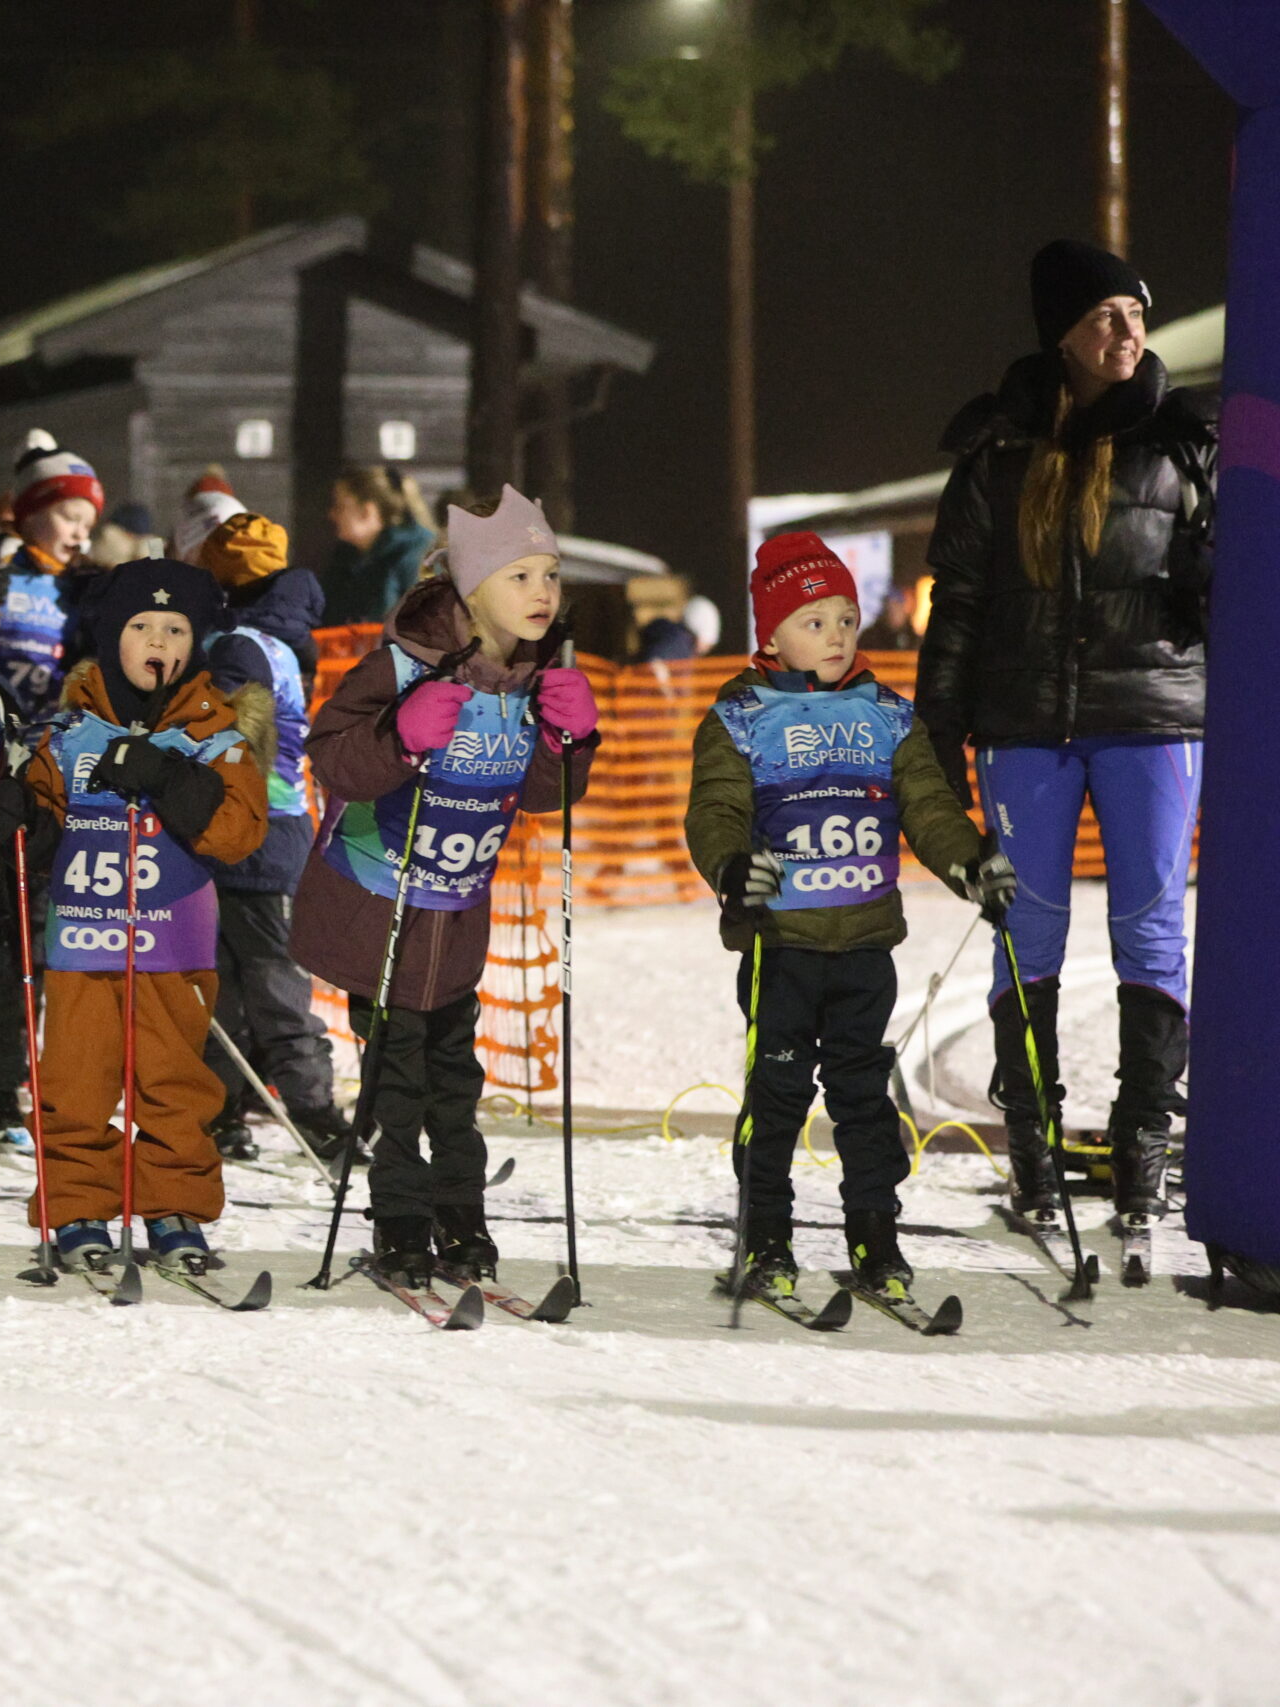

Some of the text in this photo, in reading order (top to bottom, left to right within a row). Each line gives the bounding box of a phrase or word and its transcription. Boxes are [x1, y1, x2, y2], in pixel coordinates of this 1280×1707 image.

[483, 731, 530, 759] VVS
[818, 721, 874, 748] VVS
[441, 756, 528, 776] EKSPERTEN
[788, 748, 875, 769] EKSPERTEN
[422, 789, 502, 813] SpareBank
[65, 815, 155, 833] SpareBan 1
[786, 815, 883, 858] 166
[413, 824, 506, 873] 196
[64, 844, 160, 897] 456
[792, 863, 884, 892] coop
[107, 907, 172, 922] MII-VM
[562, 848, 571, 994] FISCHER
